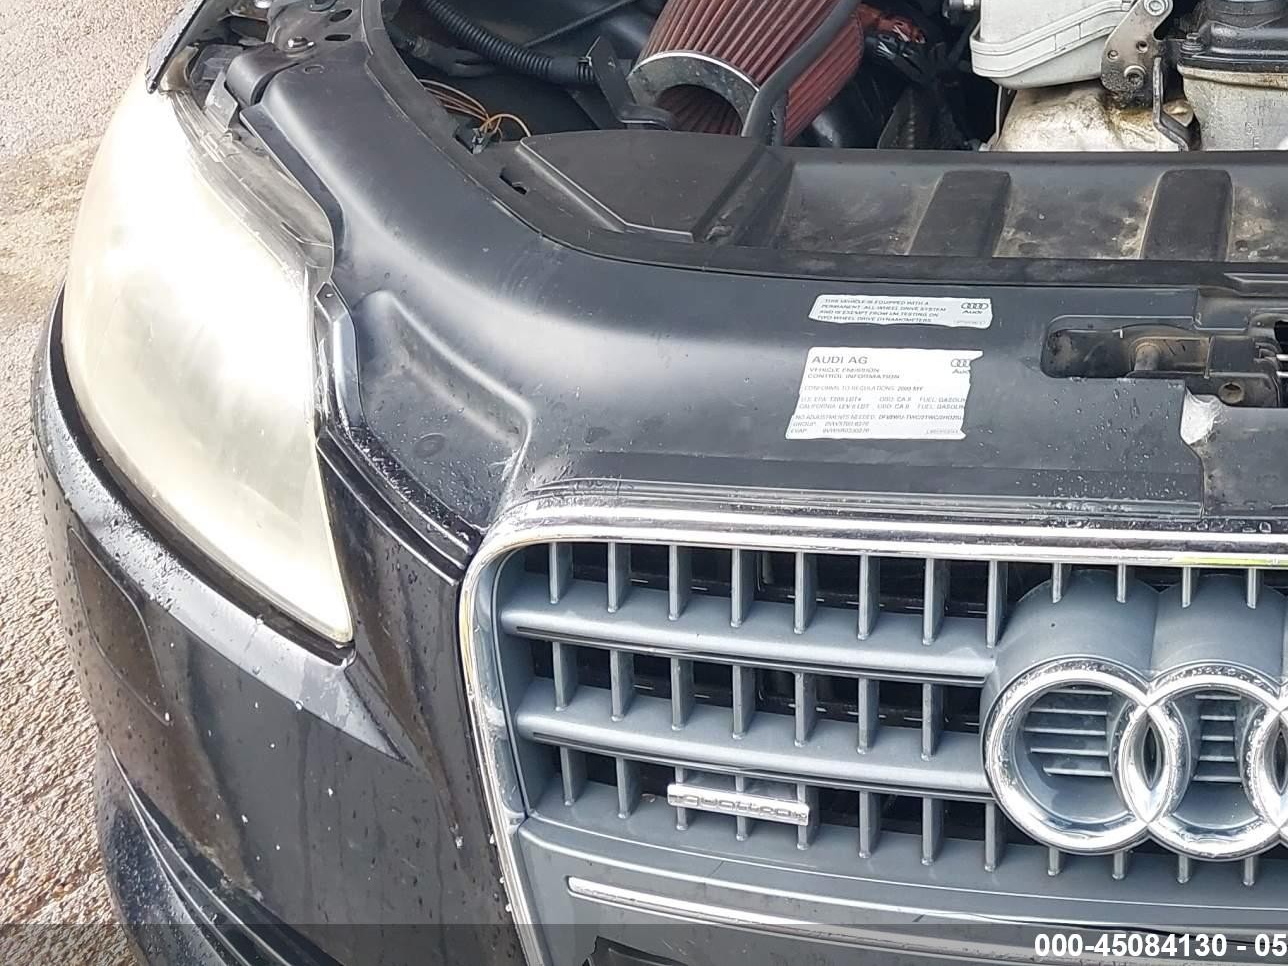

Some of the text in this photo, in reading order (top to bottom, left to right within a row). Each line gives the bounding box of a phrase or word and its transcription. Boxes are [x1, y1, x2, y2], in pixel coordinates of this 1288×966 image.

[811, 355, 869, 365] AUDI AG
[683, 794, 793, 818] quattro
